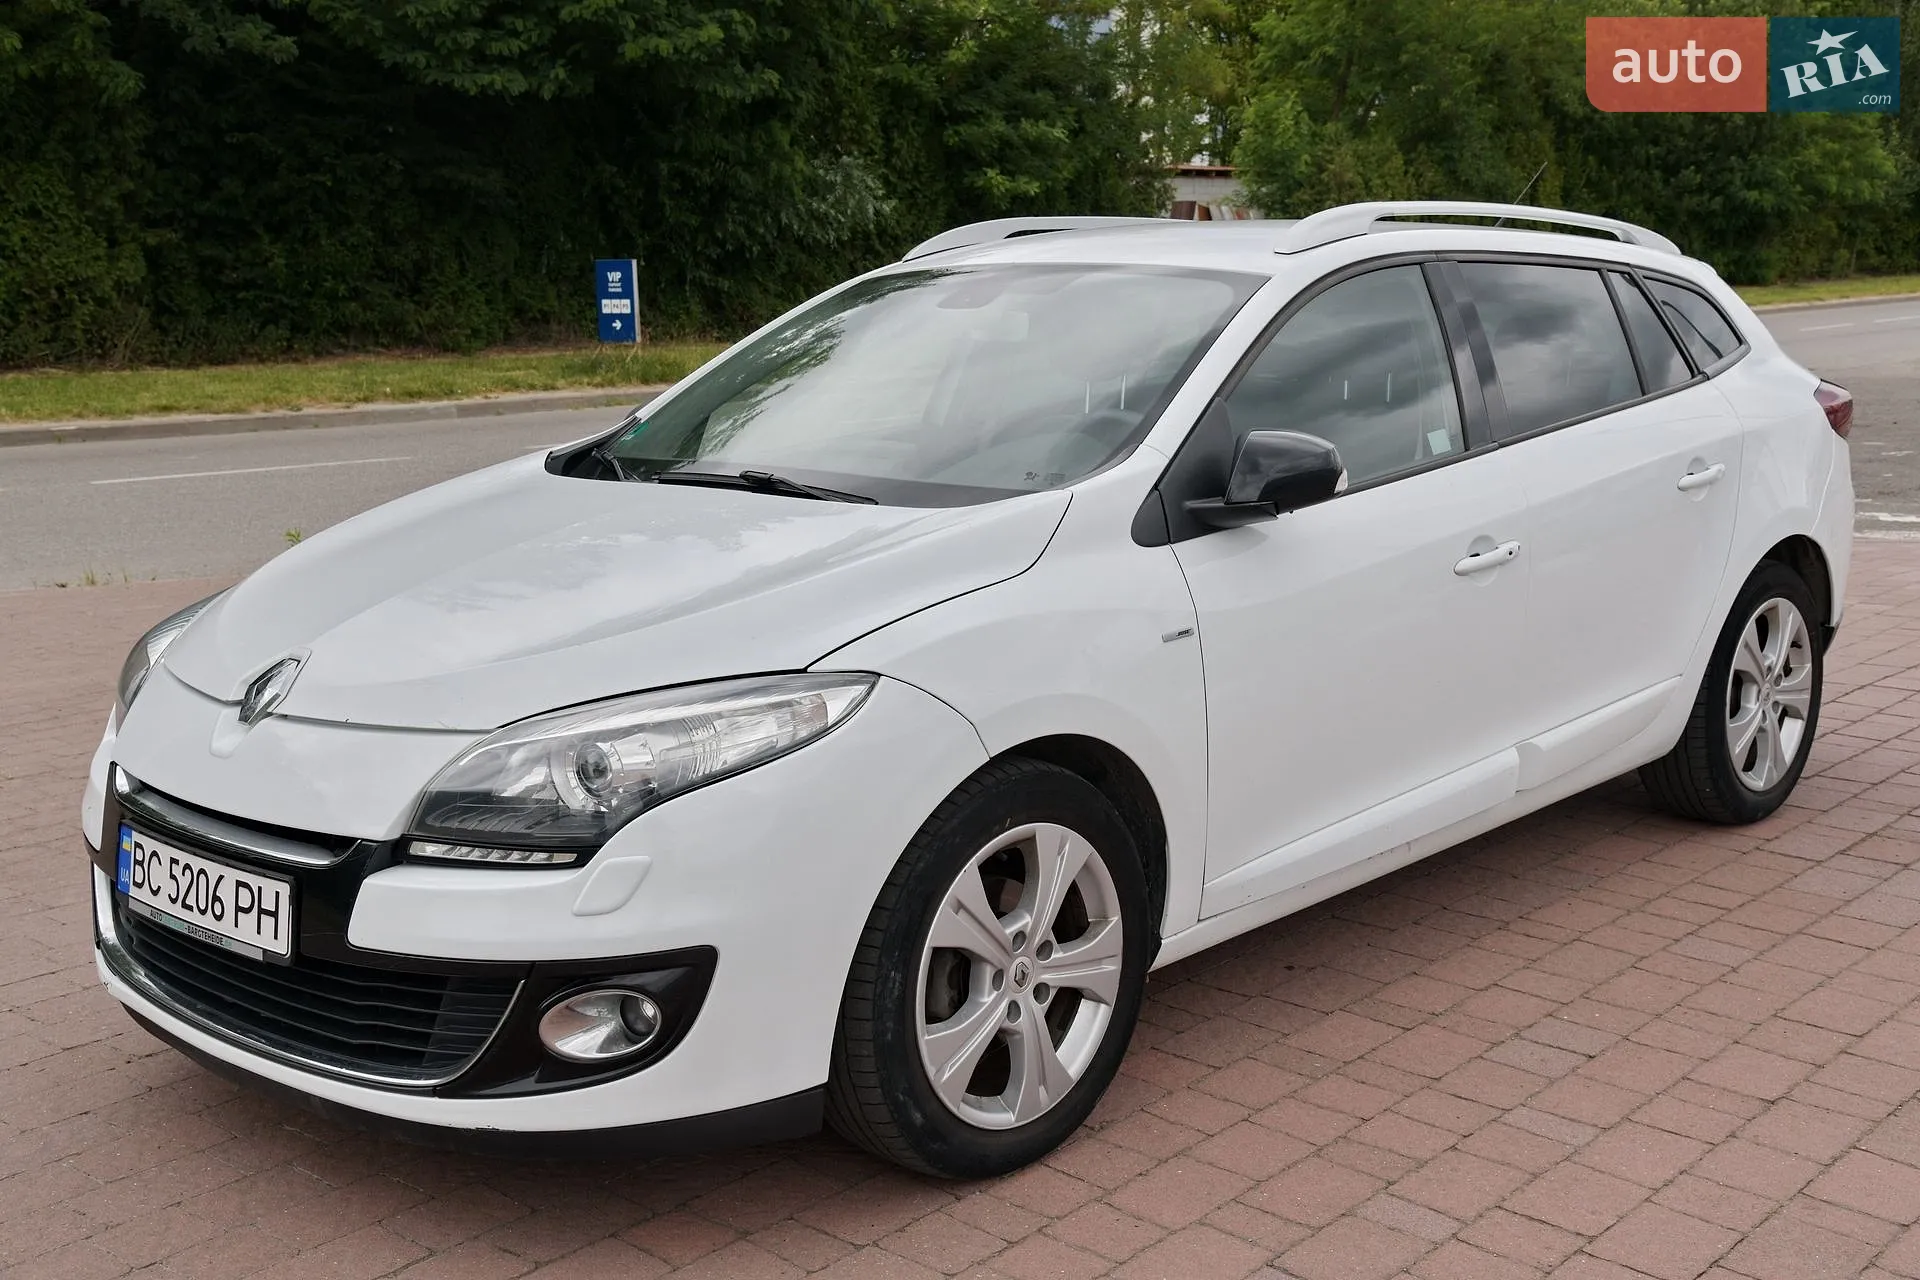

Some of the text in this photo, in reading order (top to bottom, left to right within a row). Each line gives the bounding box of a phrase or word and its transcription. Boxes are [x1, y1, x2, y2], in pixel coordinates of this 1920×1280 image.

[607, 271, 622, 282] VIP
[120, 868, 130, 885] UA
[132, 841, 280, 940] BC 5206 PH
